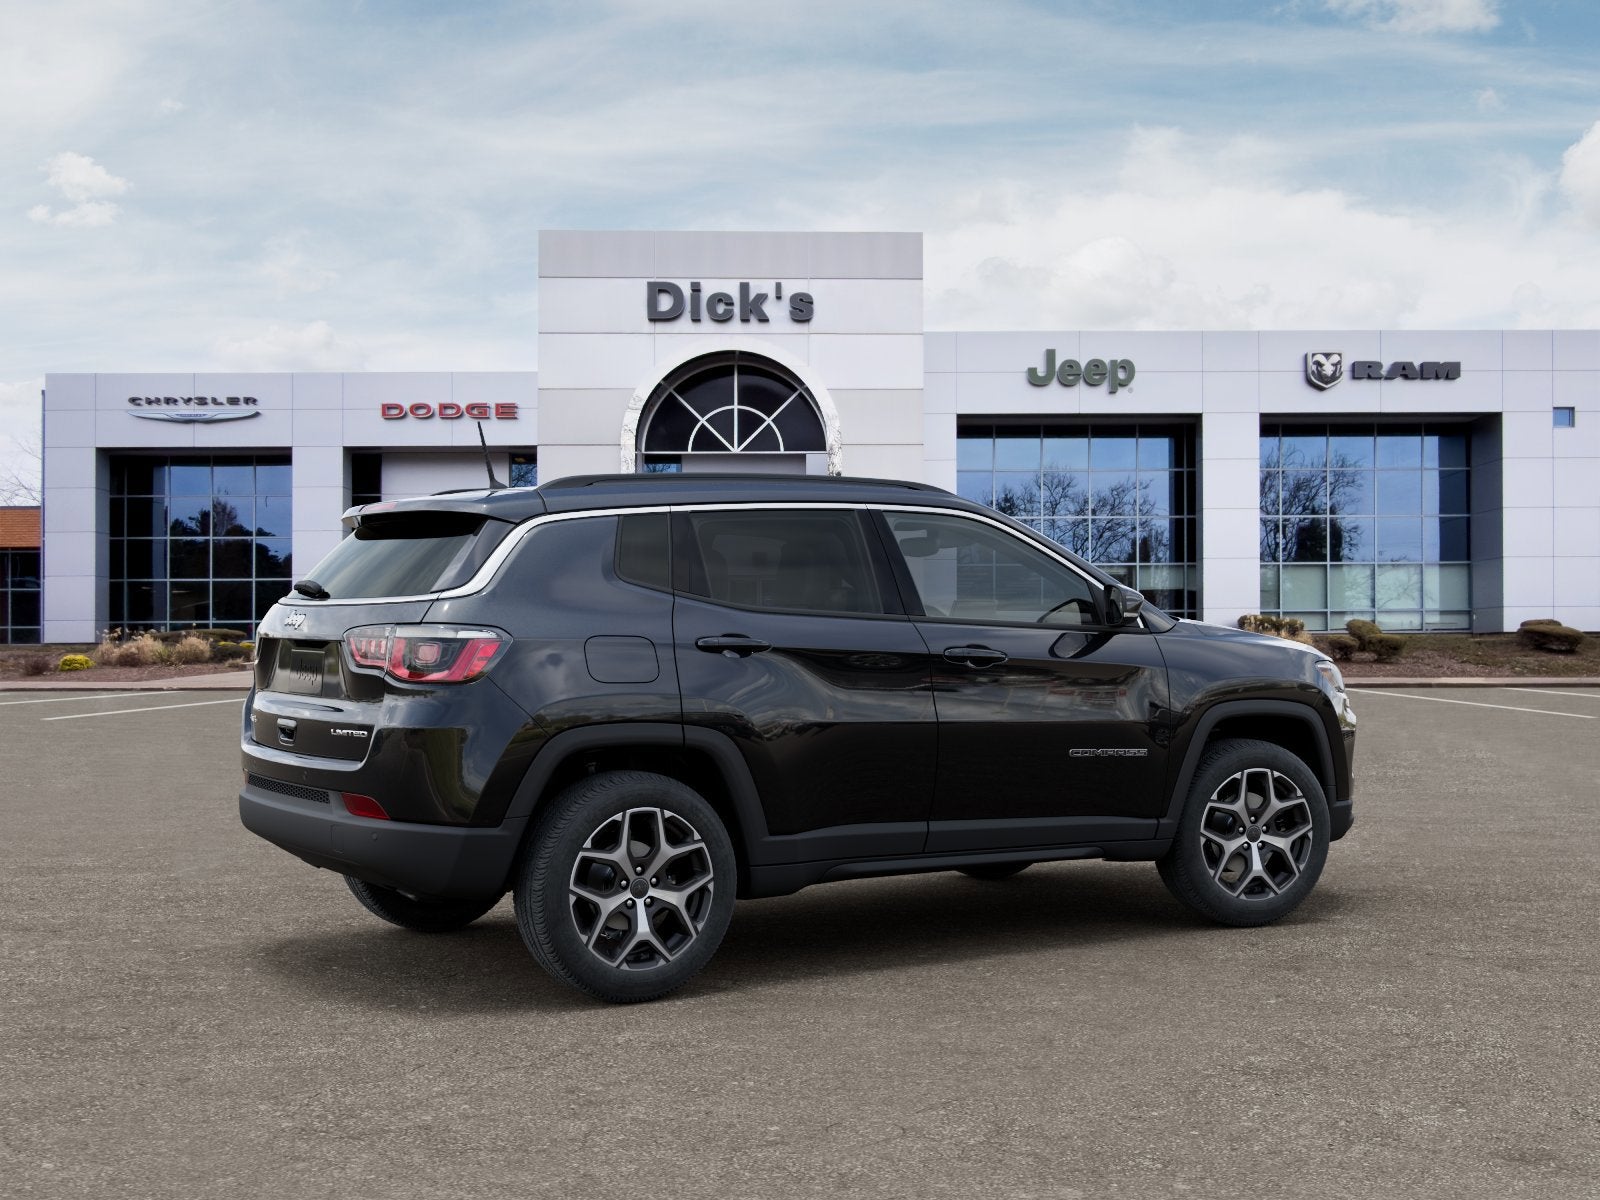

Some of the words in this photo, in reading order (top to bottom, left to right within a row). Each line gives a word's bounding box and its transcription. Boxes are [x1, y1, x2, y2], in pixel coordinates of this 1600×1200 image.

[647, 281, 814, 322] Dick's
[1026, 348, 1136, 394] Jeep
[1351, 360, 1461, 380] RAM
[127, 396, 259, 407] CHRYSLER
[381, 402, 519, 420] DODGE
[330, 728, 368, 738] LIMITED
[1069, 748, 1148, 757] COMPASS
